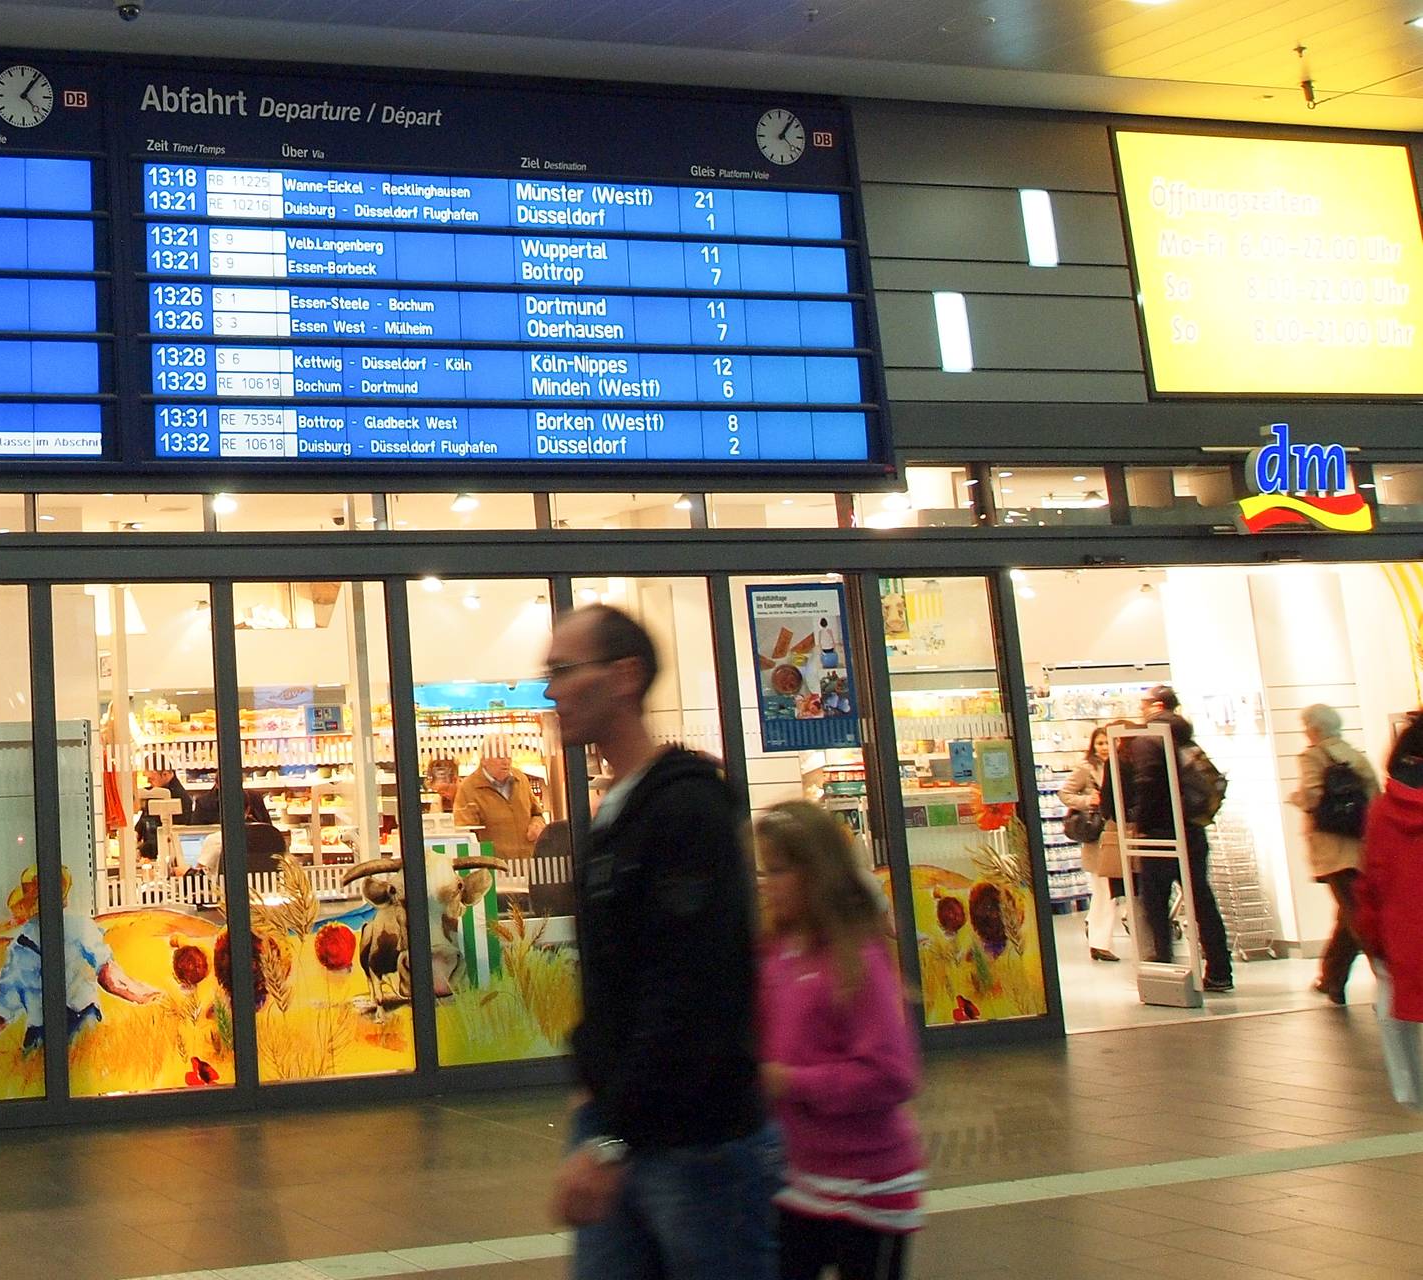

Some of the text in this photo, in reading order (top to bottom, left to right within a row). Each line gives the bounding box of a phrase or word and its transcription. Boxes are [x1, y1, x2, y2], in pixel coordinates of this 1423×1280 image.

[65, 92, 86, 106] DB
[141, 85, 442, 128] Abfahrt Departure Départ
[814, 133, 832, 146] DB
[147, 140, 715, 177] Zeit Time/Temps Über Ziel Destination Gleis
[149, 168, 652, 205] 13:18 Wanne-Eickel Recklinghausen Münster (Westf)
[149, 191, 604, 225] 13:21 Duisburg Düsseldorf Flughafen Düsseldorf
[152, 227, 607, 262] 13:21 Velb.Langenberg Wuppertal
[1366, 239, 1400, 261] Uhr
[152, 251, 583, 285] 13:21 Essen-Borbeck Bottrop
[154, 287, 606, 315] 13:26 Essen-Steele Bochum Dortmund
[1373, 280, 1406, 303] Uhr
[155, 311, 623, 338] 13:26 Essen West Mülheim Oberhausen
[1173, 317, 1197, 341] So
[1377, 320, 1412, 344] Uhr
[157, 348, 627, 377] 13:28 Kettwig Düsseldorf Köln Köln-Nippes
[158, 372, 659, 396] 13:29 RE 10619 Bochum Dortmund Minden (Westf)
[161, 409, 663, 431] 13:31 RE 75354 Bottrop Gladbeck West Borken (Westf)
[161, 433, 209, 451] 13:32
[222, 438, 236, 449] RE
[300, 440, 350, 455] Duisburg
[371, 440, 435, 452] Düsseldorf
[442, 441, 497, 456] Flughafen
[537, 436, 626, 453] Düsseldorf
[1255, 423, 1347, 493] dm
